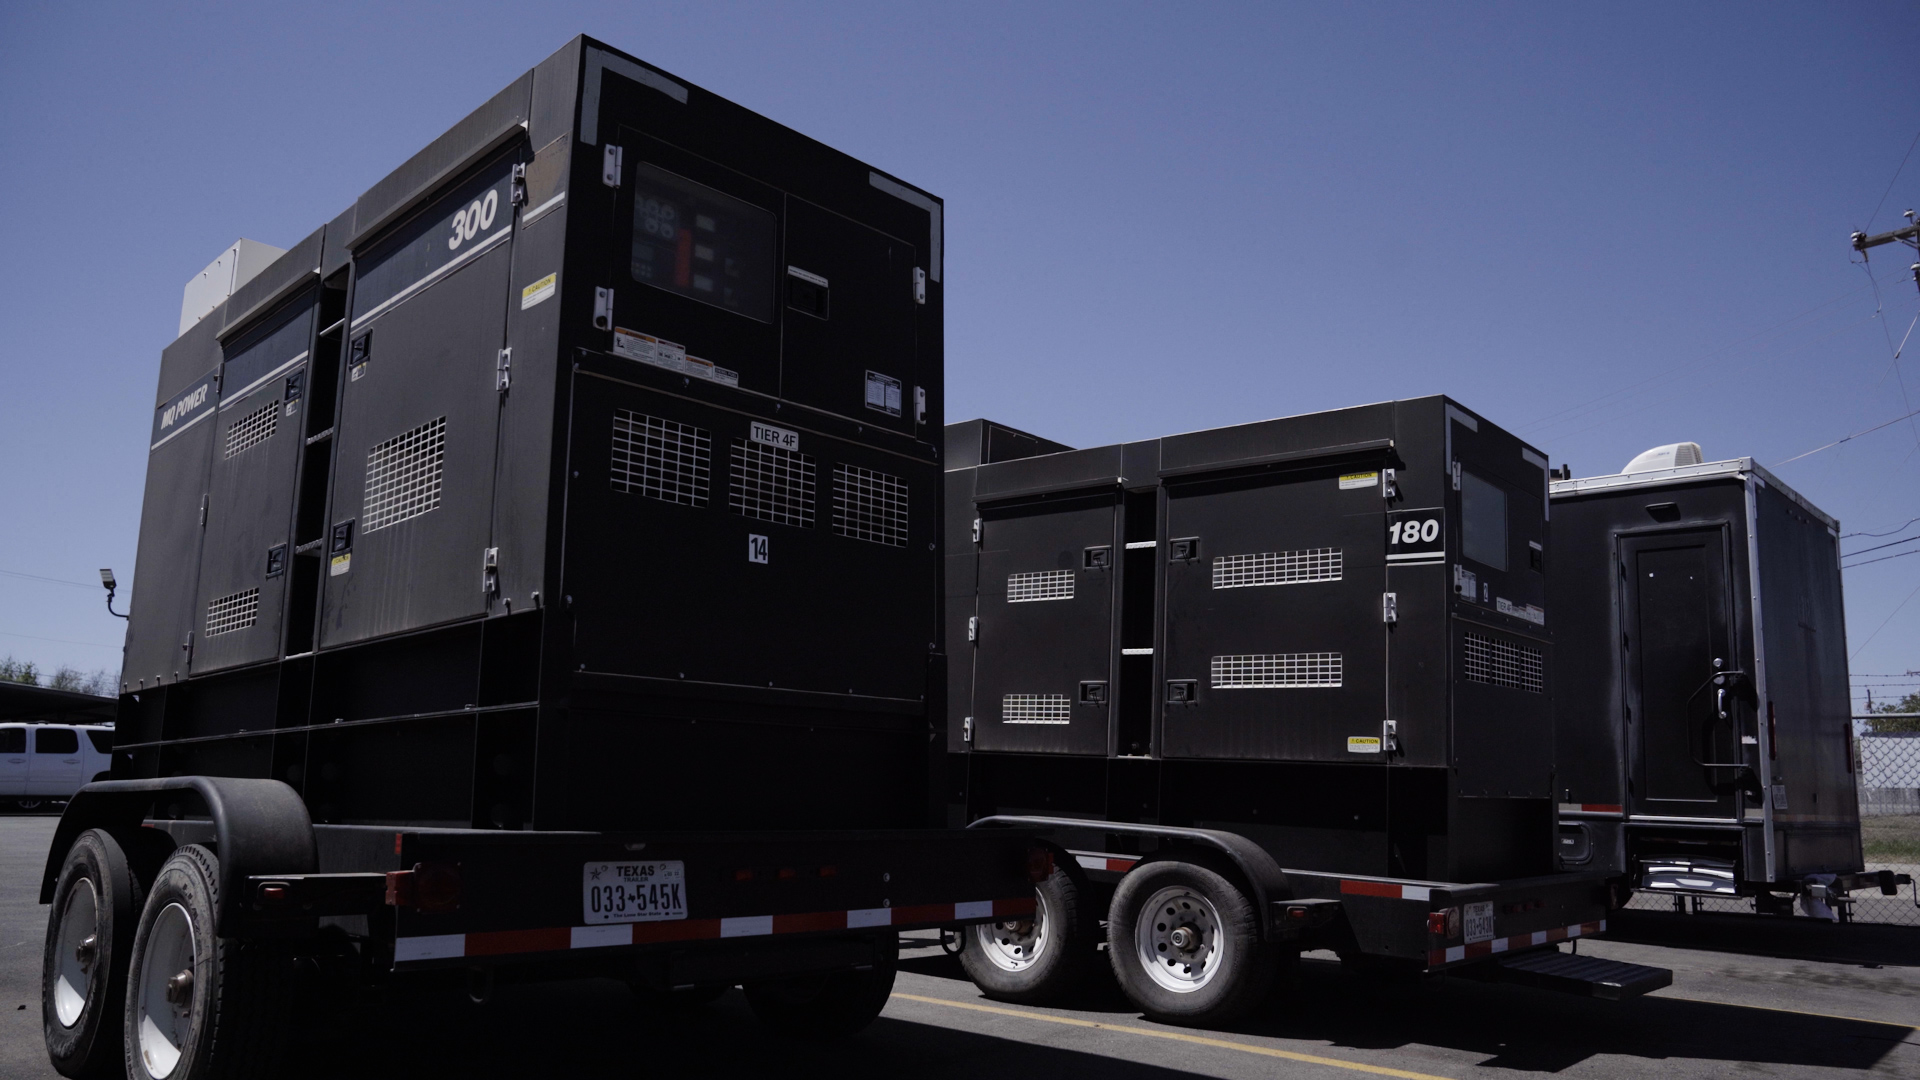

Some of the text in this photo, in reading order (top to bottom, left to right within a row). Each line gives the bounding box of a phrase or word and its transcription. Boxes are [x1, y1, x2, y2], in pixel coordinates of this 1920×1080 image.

[449, 189, 498, 250] 300
[531, 278, 551, 292] CAUTION
[161, 383, 208, 430] MQ POWER
[753, 425, 796, 447] TIER 4F
[1350, 472, 1372, 480] CAUTION
[1389, 519, 1439, 545] 180
[750, 537, 768, 561] 14
[616, 865, 655, 877] TEXAS
[591, 883, 682, 913] 033 545K
